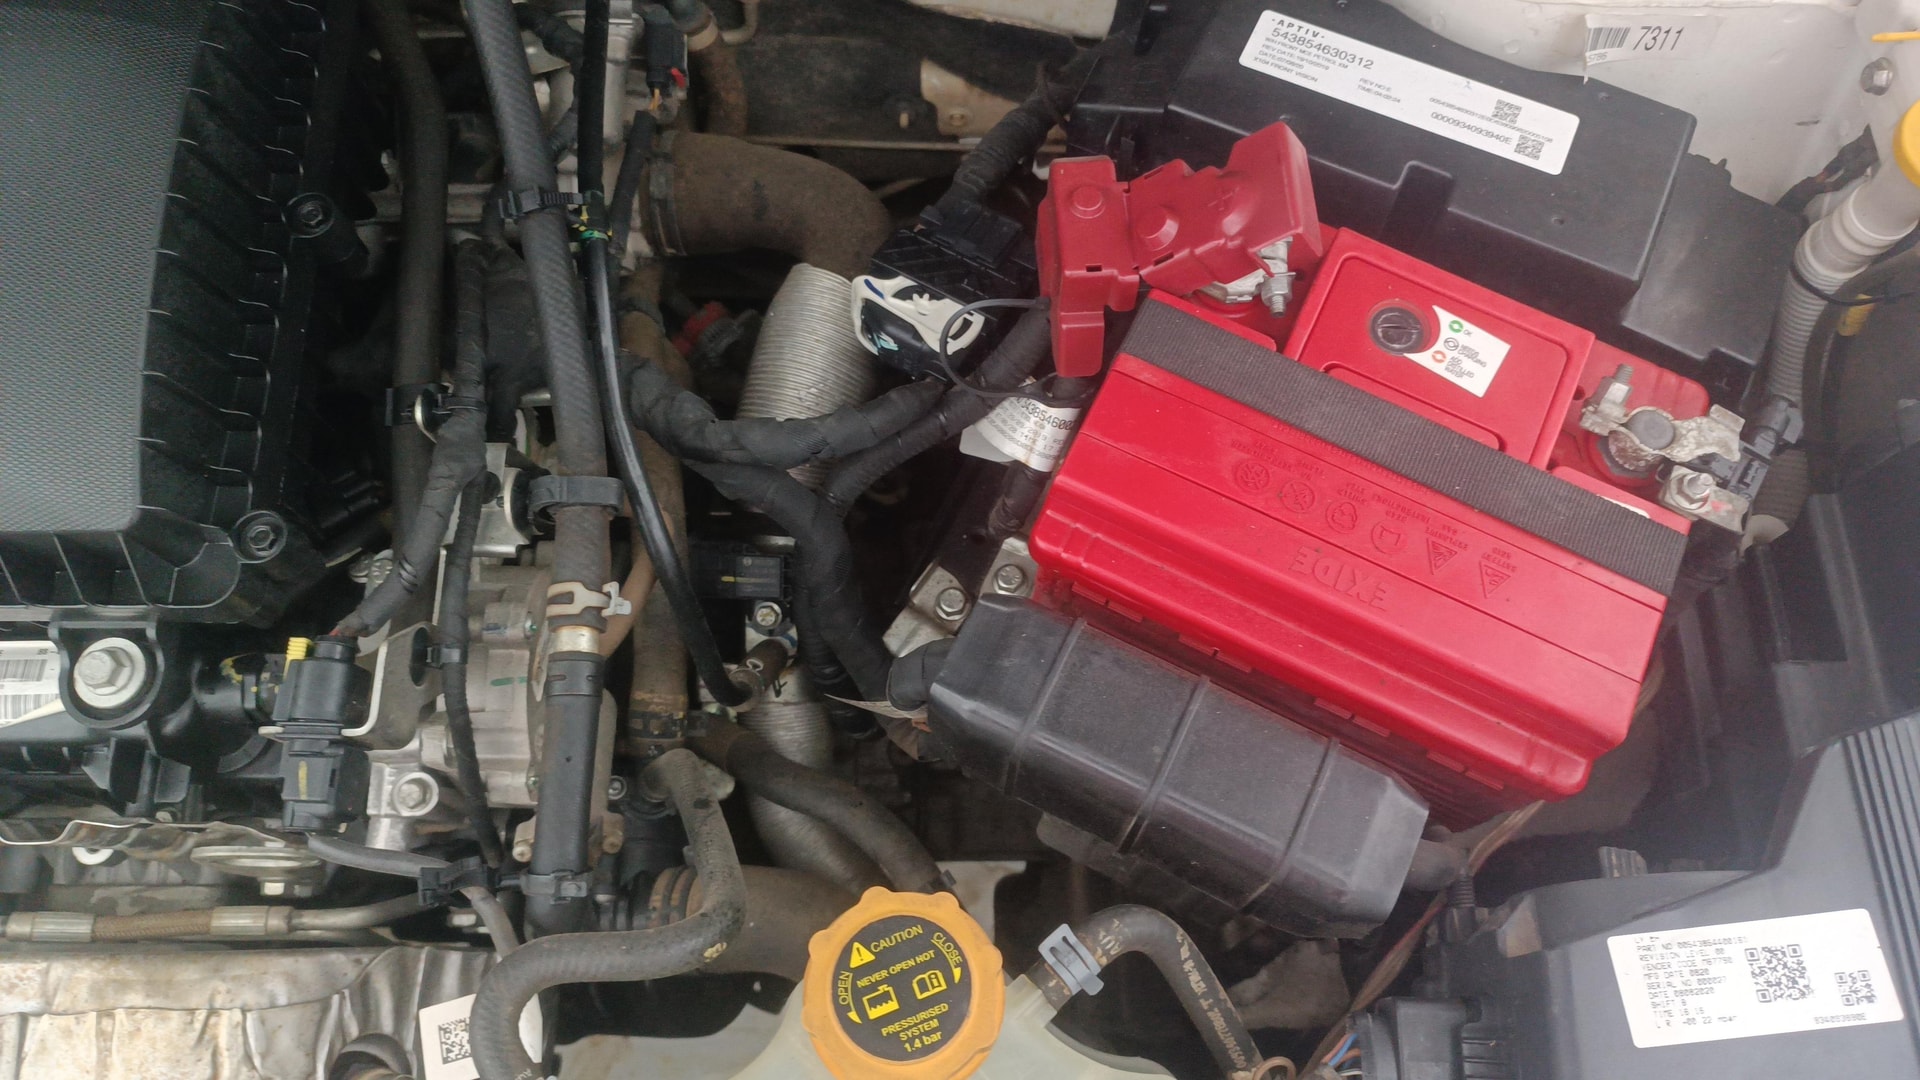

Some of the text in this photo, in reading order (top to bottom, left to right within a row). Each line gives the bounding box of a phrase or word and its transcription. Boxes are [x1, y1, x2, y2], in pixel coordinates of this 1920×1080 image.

[1276, 19, 1320, 38] APTIV
[1632, 26, 1684, 51] 7311
[1271, 27, 1374, 70] 543854630312
[1288, 546, 1387, 612] EXIDE
[870, 924, 924, 953] CAUTION
[932, 932, 963, 966] CLOSE
[856, 949, 936, 988] NEVER OPEN HOT
[838, 970, 851, 1005] OPEN
[881, 1002, 949, 1037] PRESSURISED
[899, 1018, 939, 1041] SYSTEM
[904, 1031, 943, 1053] 1.4 bar
